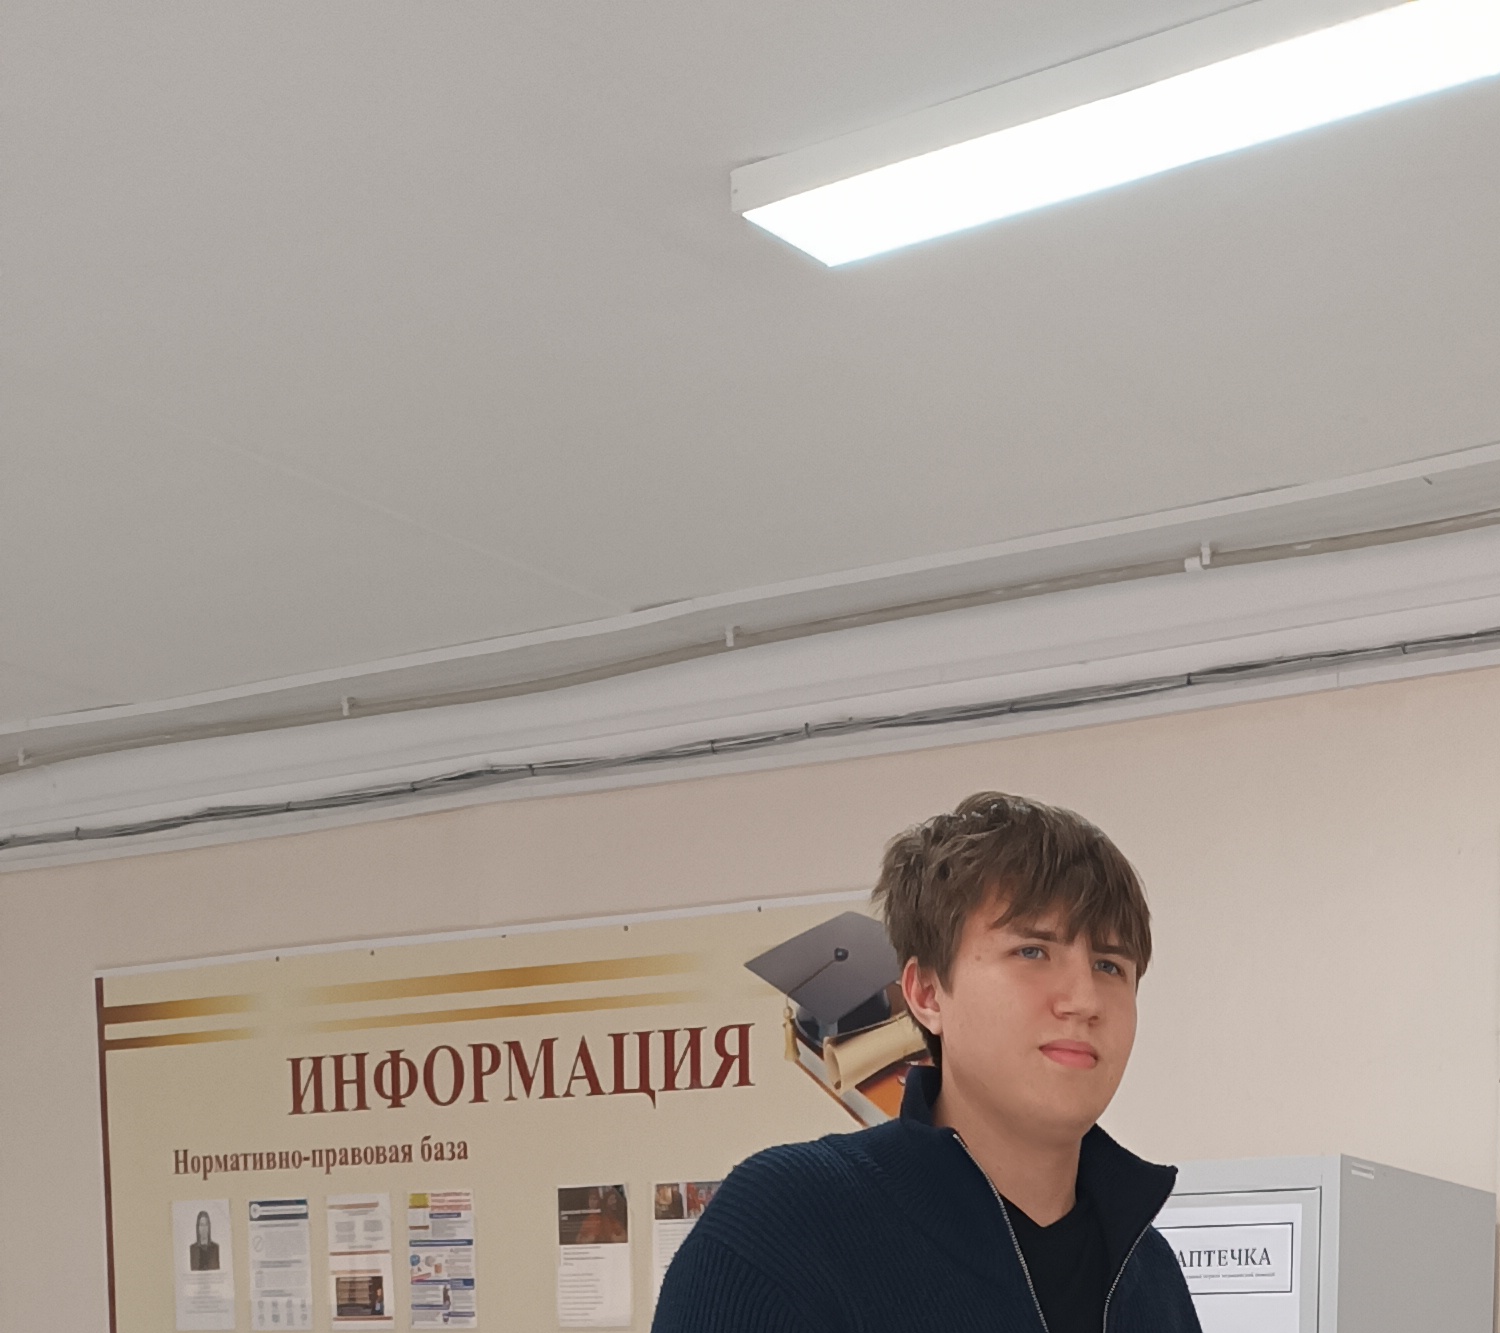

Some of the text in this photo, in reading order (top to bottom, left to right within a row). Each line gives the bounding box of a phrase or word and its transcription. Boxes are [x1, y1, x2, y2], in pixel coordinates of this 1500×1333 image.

[286, 1022, 756, 1116] ИНФОРМАЦИЯ
[173, 1135, 469, 1181] Нормативно-правовая база
[1177, 1247, 1271, 1268] АПТЕЧКА
